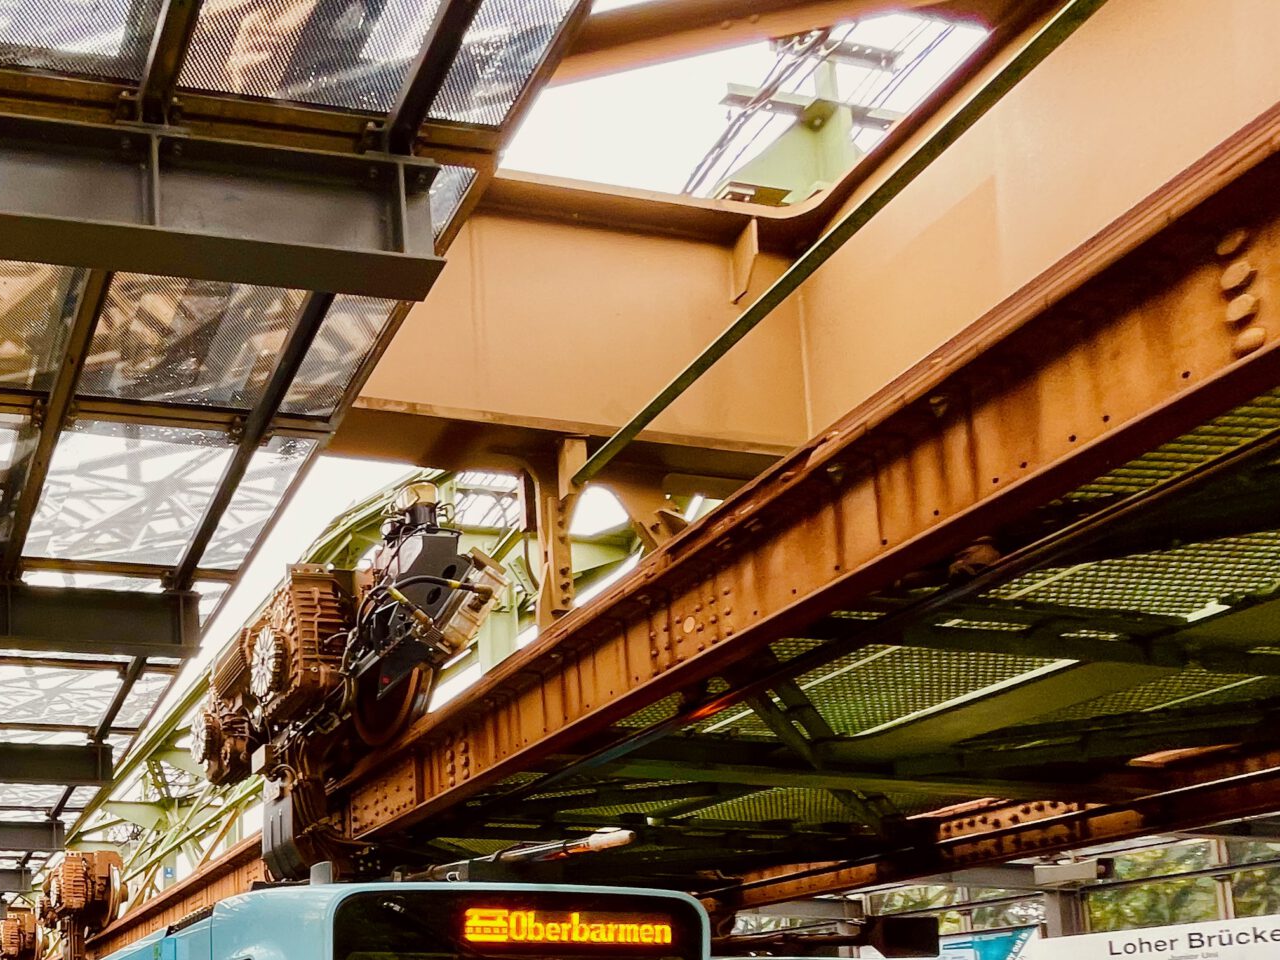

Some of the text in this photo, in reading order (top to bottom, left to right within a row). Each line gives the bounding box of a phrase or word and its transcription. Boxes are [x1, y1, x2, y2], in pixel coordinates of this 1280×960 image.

[509, 911, 672, 943] Oberbarmen
[1108, 927, 1280, 956] Loher Brücke
[1012, 939, 1024, 953] out
